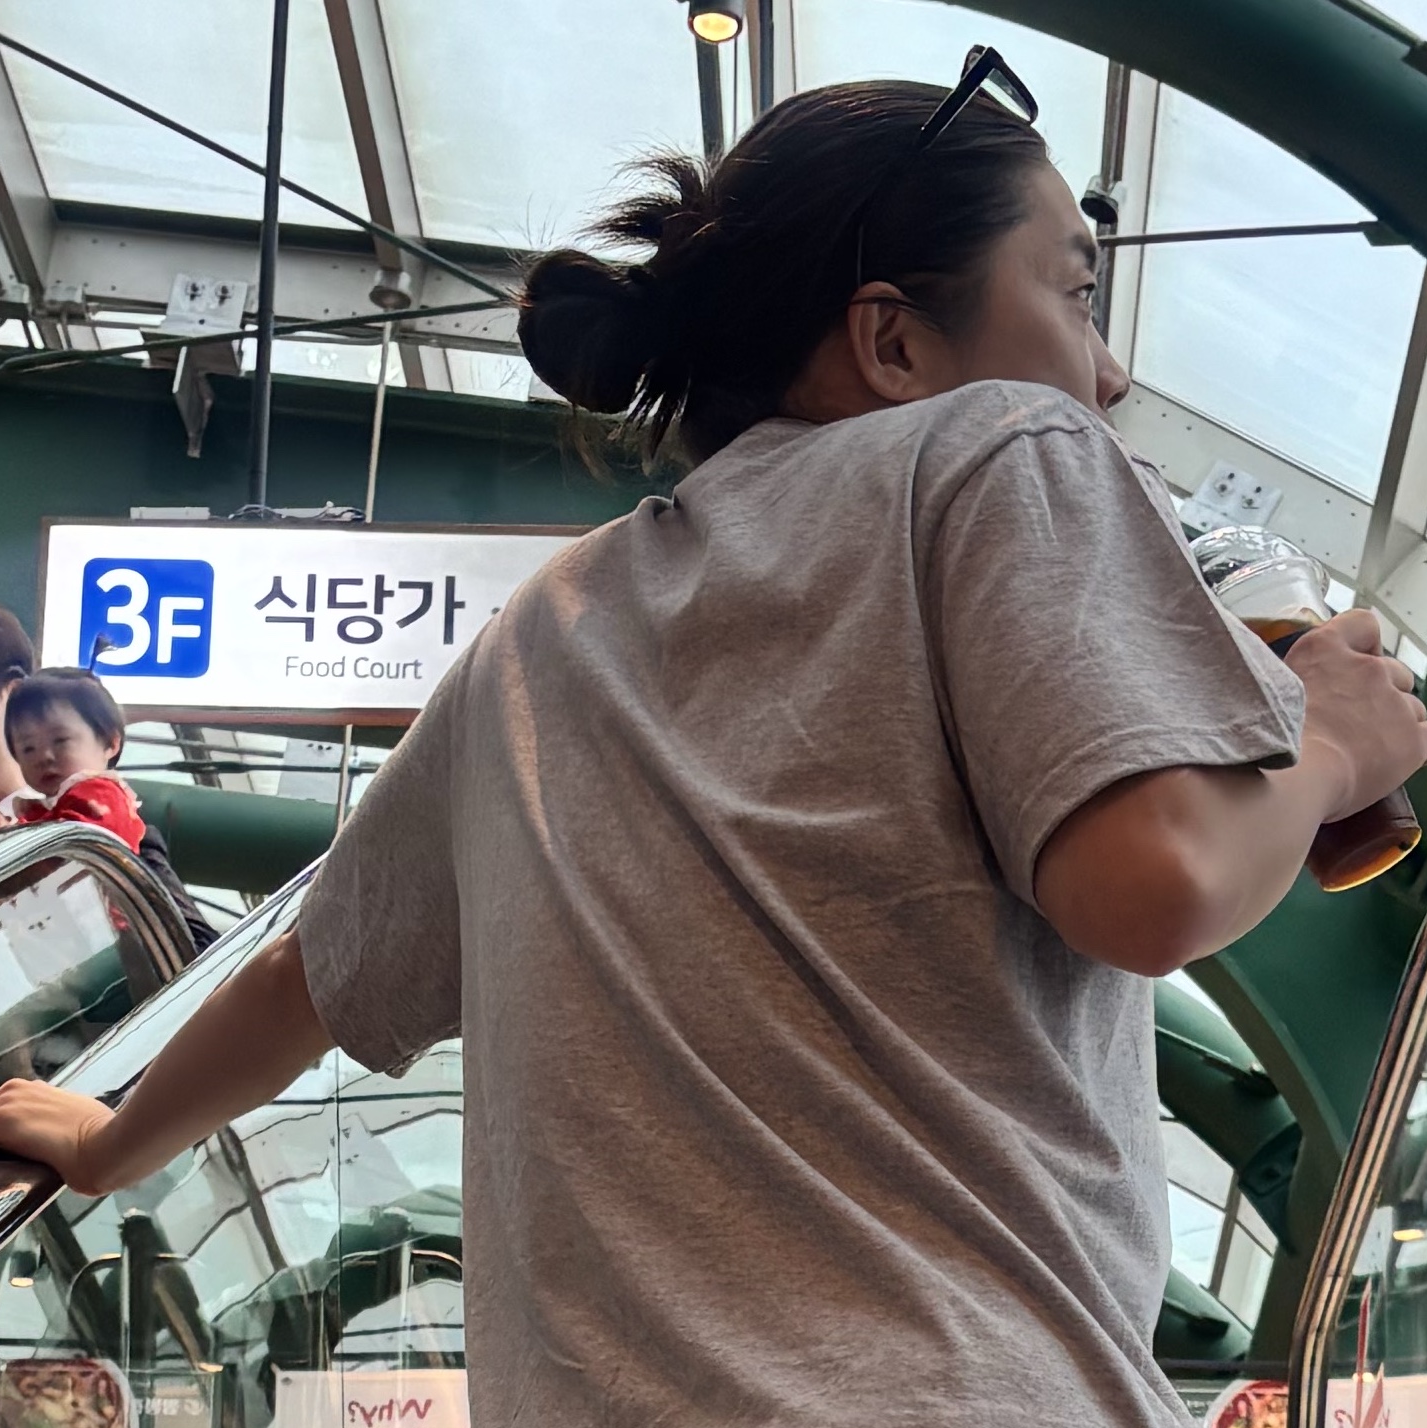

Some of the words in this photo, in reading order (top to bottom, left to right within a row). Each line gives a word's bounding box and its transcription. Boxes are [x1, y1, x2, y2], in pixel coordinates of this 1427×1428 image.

[95, 568, 205, 666] 3F
[254, 573, 466, 645] 식당가
[285, 655, 346, 678] Food
[353, 656, 423, 680] Court
